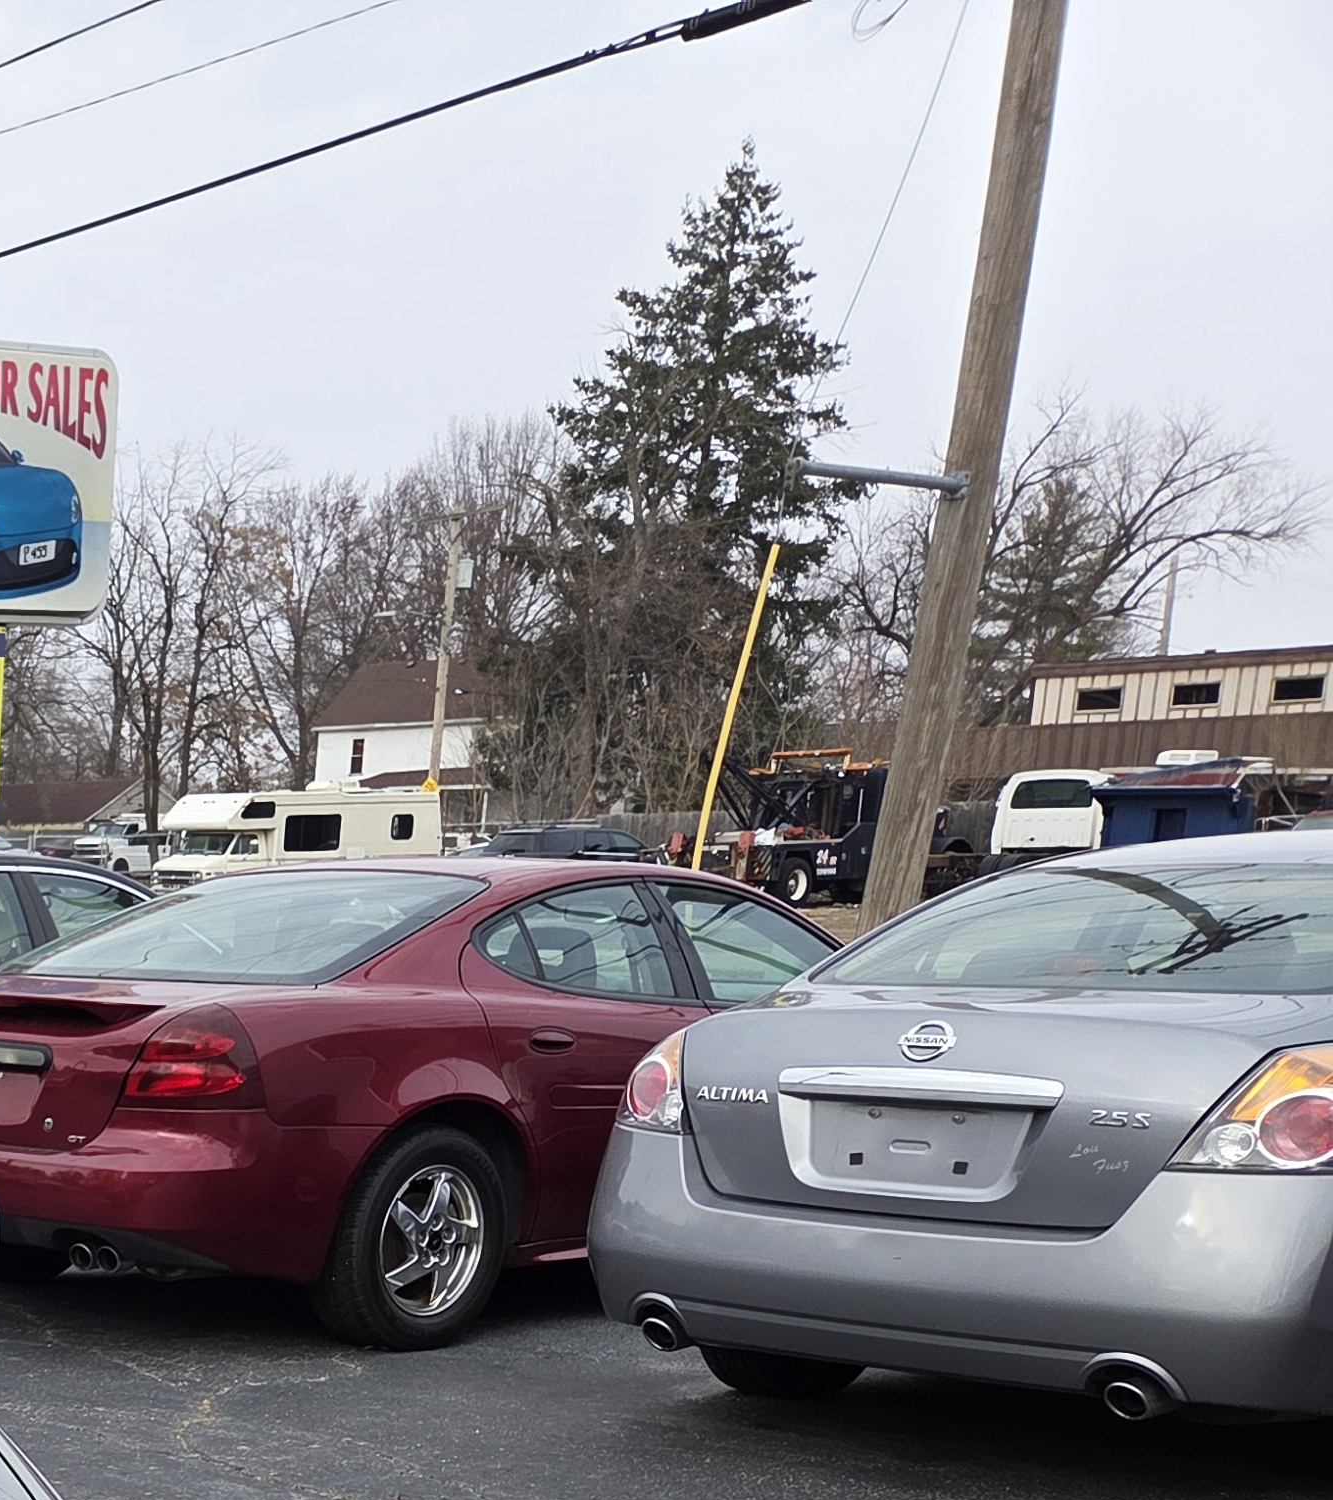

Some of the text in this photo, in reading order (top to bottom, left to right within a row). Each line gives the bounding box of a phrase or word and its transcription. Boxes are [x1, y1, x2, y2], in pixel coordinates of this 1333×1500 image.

[26, 362, 109, 460] SALES
[903, 1036, 948, 1045] NISSAN
[696, 1085, 769, 1104] ALTIMA
[67, 1134, 86, 1143] GT
